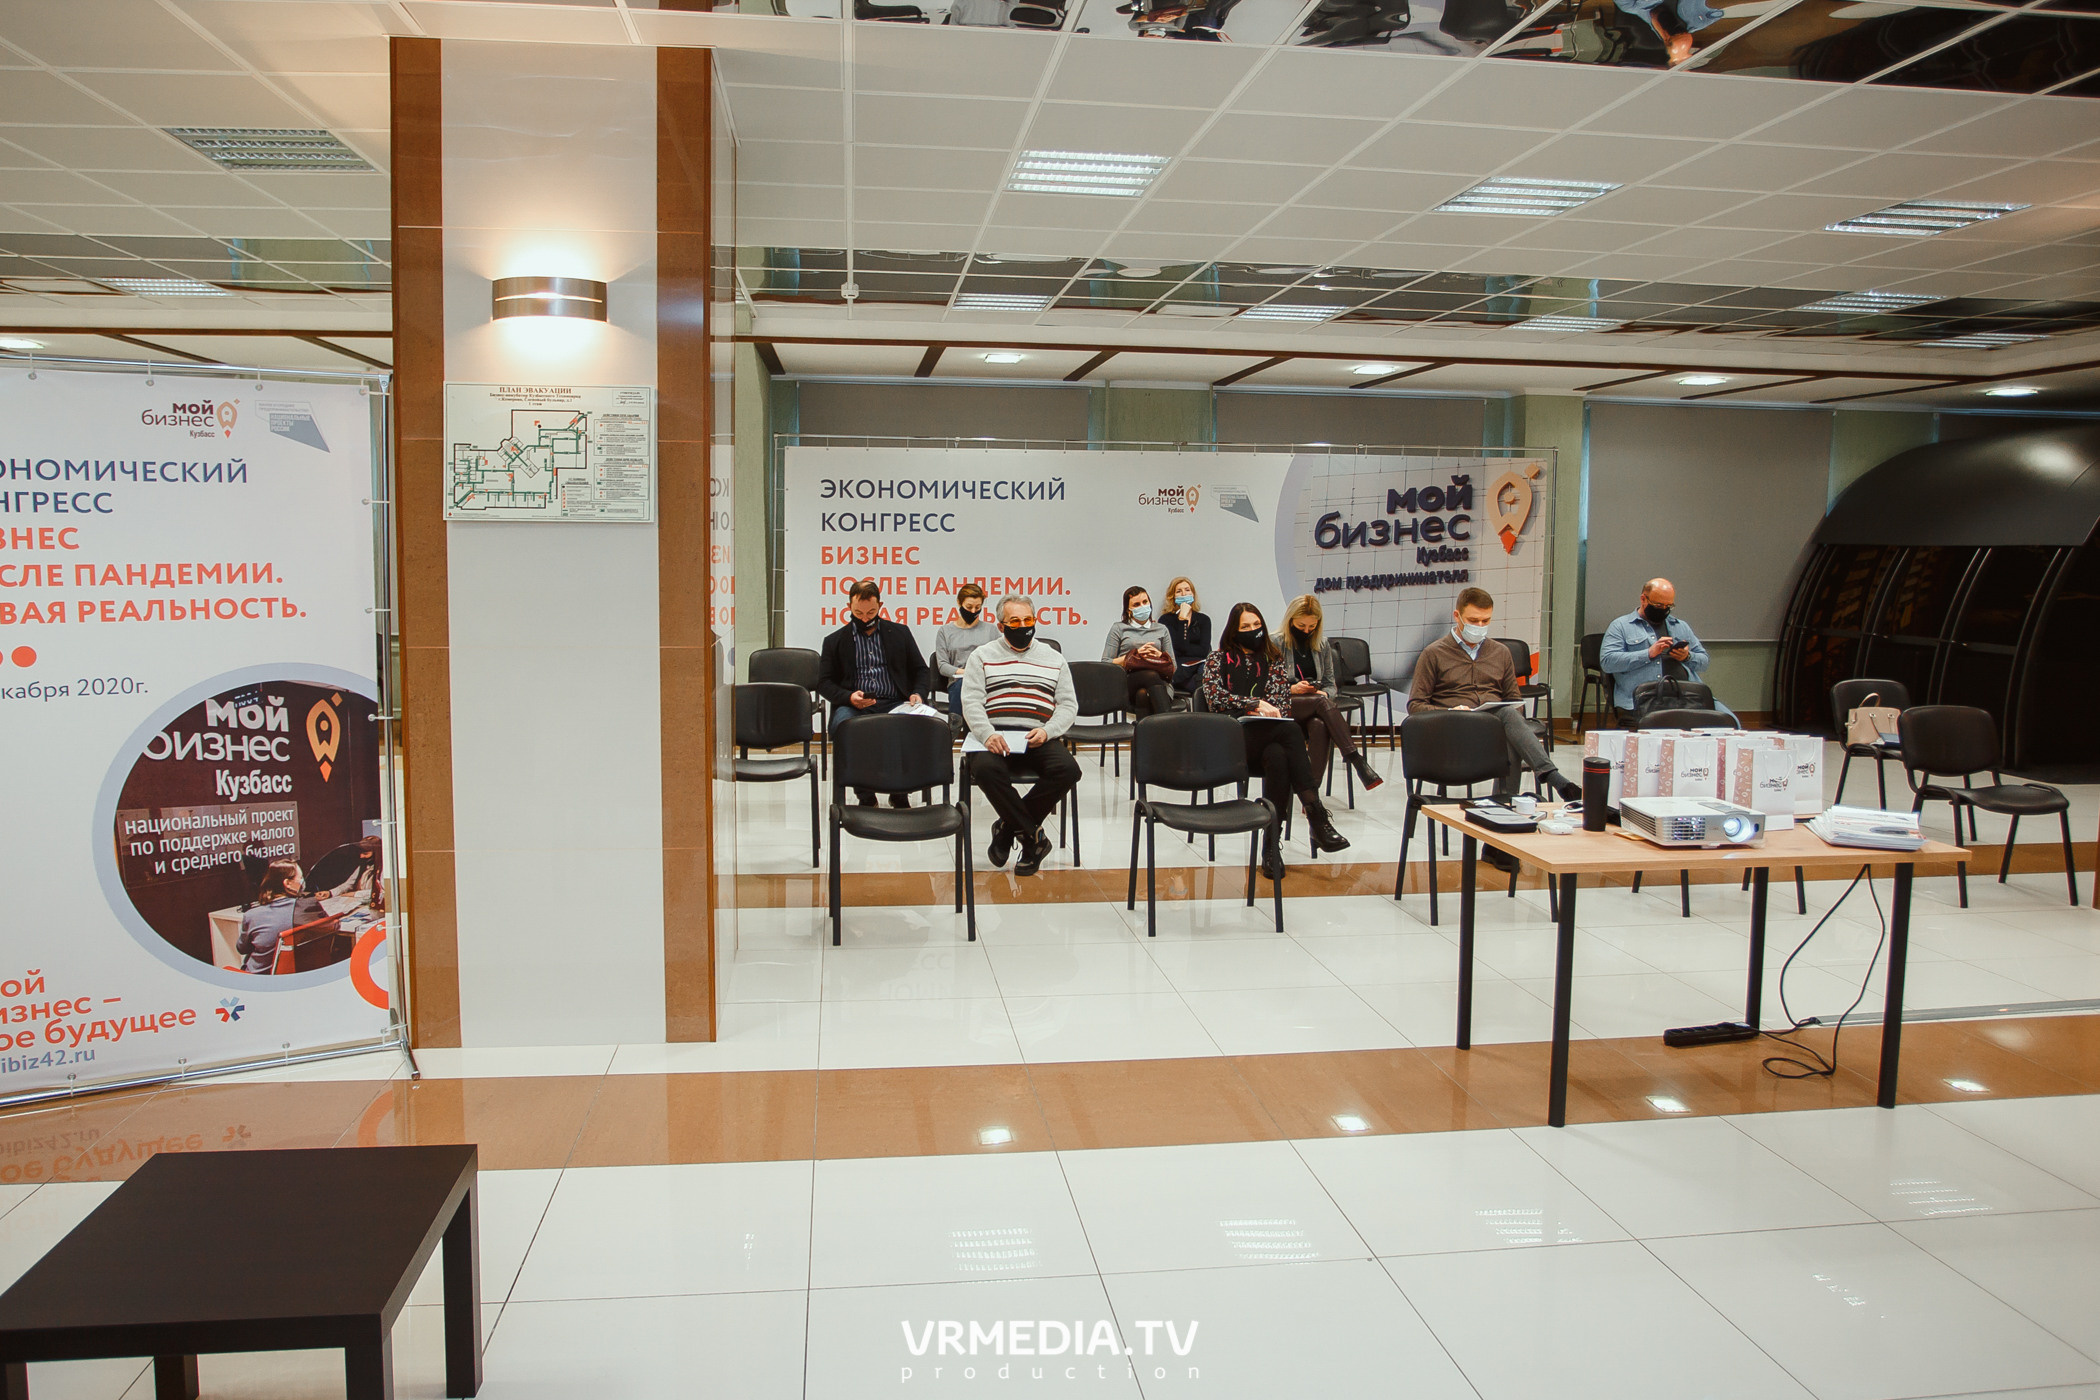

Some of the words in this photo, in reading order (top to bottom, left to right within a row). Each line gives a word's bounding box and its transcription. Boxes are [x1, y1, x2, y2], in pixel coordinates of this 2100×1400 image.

[141, 409, 214, 427] бизнес
[173, 400, 214, 414] мой
[189, 430, 215, 438] Кузбасс
[0, 458, 247, 483] НОМИЧЕСКИЙ
[820, 477, 1066, 501] ЭКОНОМИЧЕСКИЙ
[1138, 493, 1185, 506] бизнес
[1158, 485, 1184, 496] мой
[1386, 474, 1473, 514] мой
[821, 512, 956, 532] КОНГРЕСС
[1314, 511, 1471, 549] бизнес
[821, 546, 921, 565] БИЗНЕС
[1416, 544, 1469, 567] Кузбасс
[74, 562, 283, 588] ПАНДЕМИИ.
[1314, 576, 1342, 593] дом
[1346, 569, 1469, 592] предпринимателя
[0, 601, 66, 625] ВАЯ
[78, 597, 307, 623] РЕАЛЬНОСТЬ.
[821, 607, 908, 626] НОАЯ
[916, 606, 1088, 626] РЕАЬСТЬ.
[77, 677, 148, 697] 2020г.
[215, 769, 293, 802] Кузбасс
[124, 809, 248, 836] национальный
[251, 809, 294, 827] проект
[130, 840, 155, 857] по
[159, 831, 248, 854] поддержке
[251, 826, 295, 842] малого
[155, 860, 167, 875] и
[171, 850, 242, 875] среднего
[245, 842, 296, 859] бизнеса
[44, 1008, 197, 1048] будущее
[1, 1049, 96, 1074] ibiz42.ru
